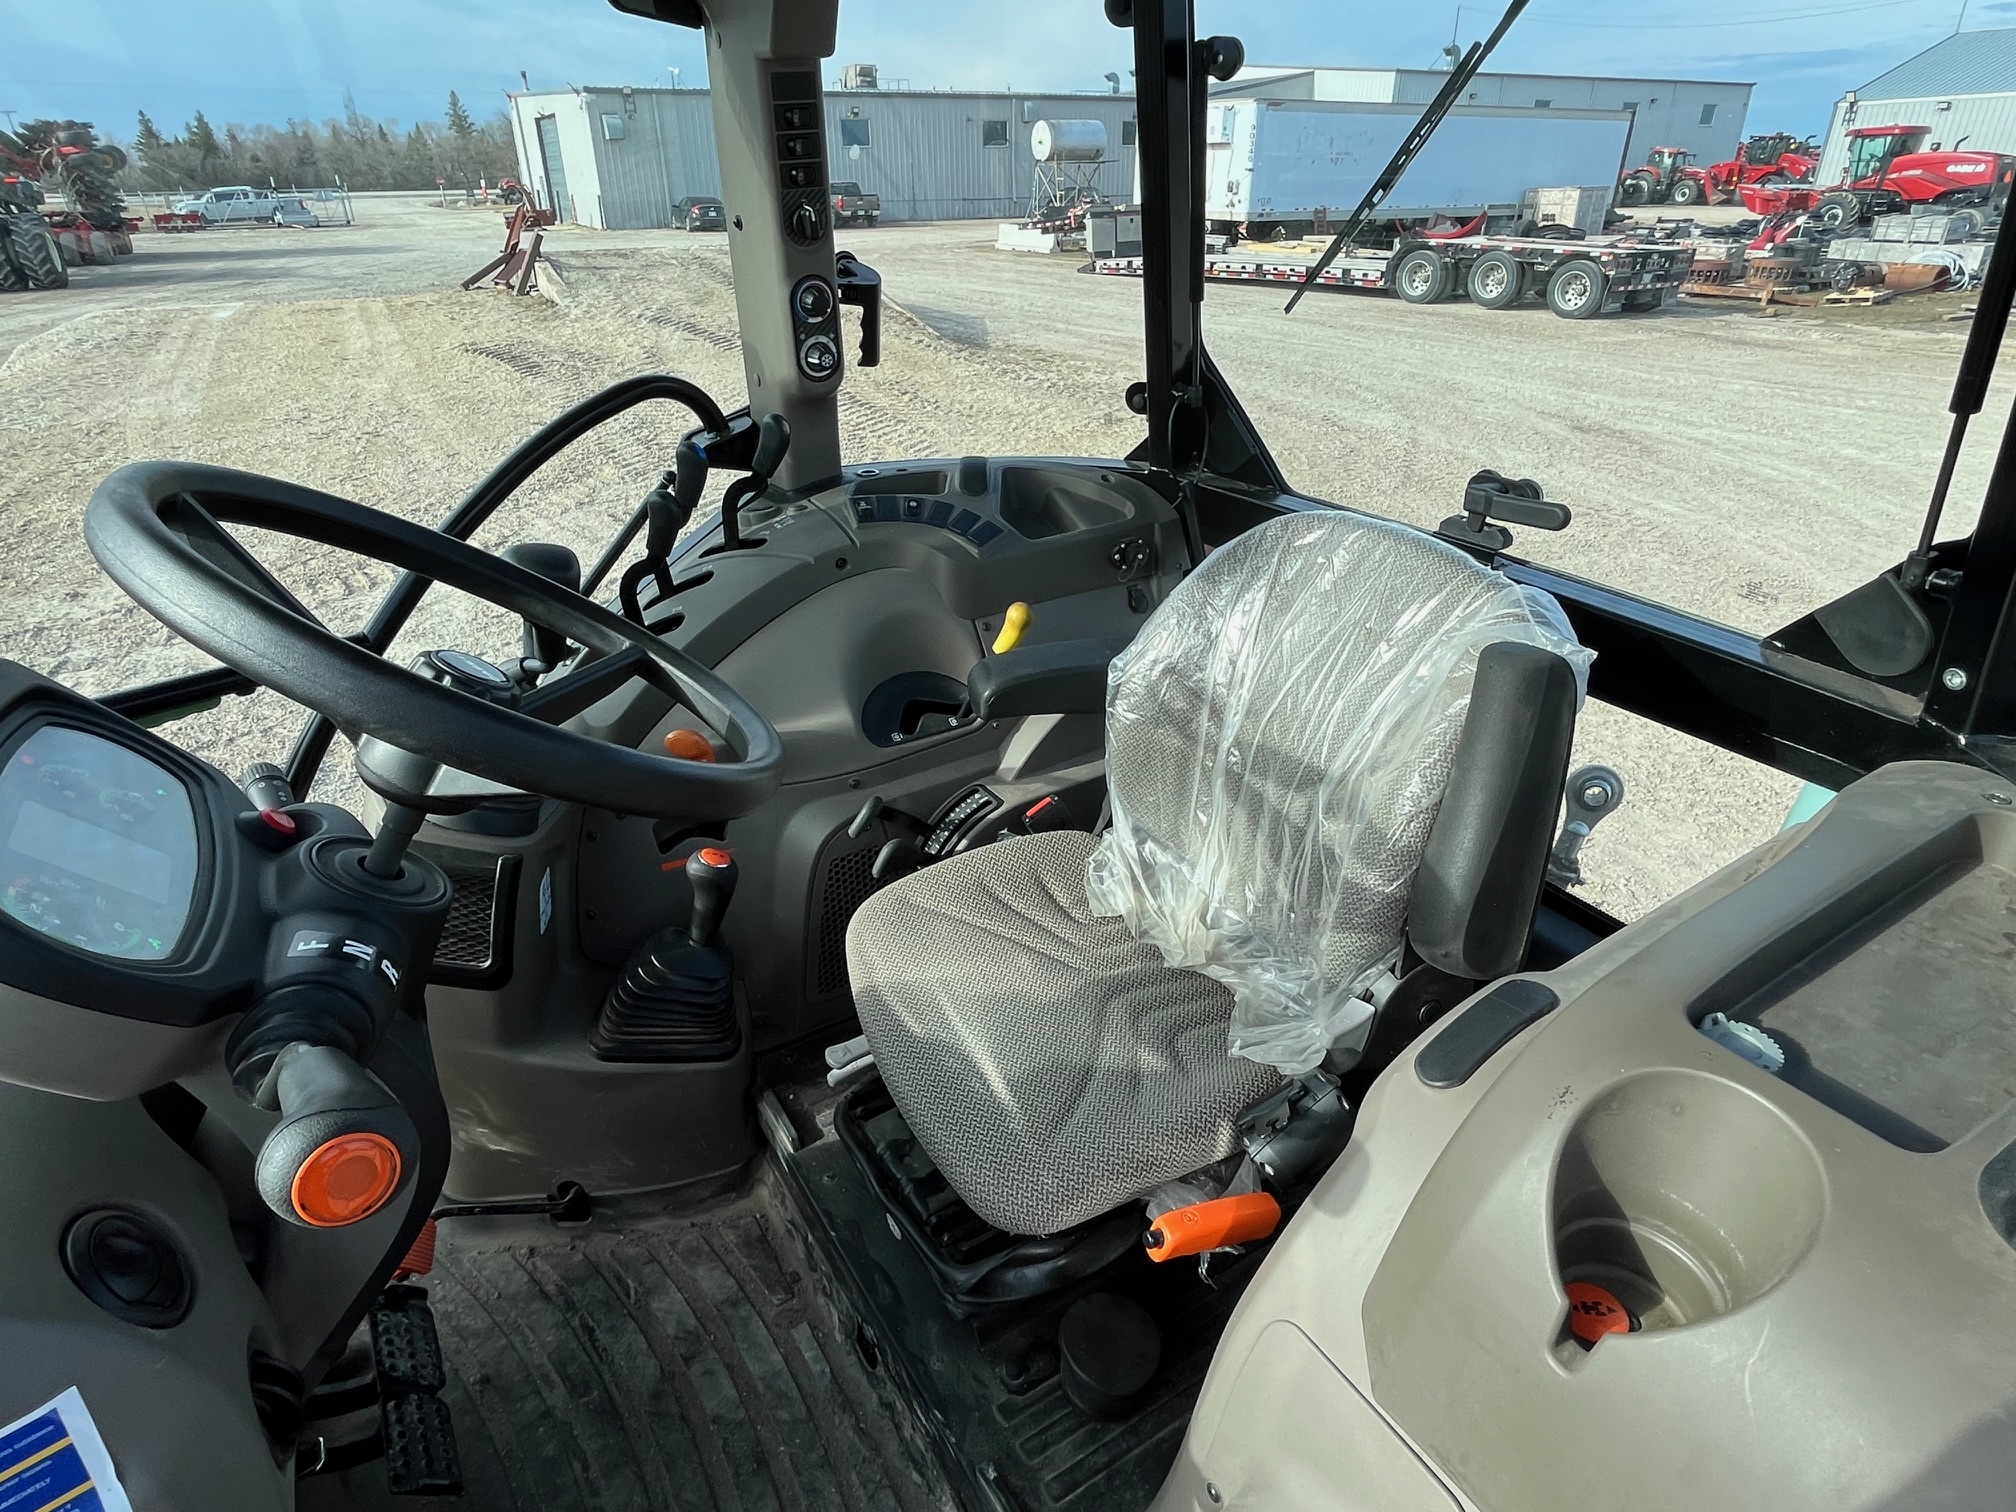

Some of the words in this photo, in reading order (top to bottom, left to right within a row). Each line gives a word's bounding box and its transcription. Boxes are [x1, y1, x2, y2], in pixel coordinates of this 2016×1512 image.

[1248, 124, 1256, 162] 90346
[297, 940, 330, 951] F
[342, 939, 374, 962] N
[380, 959, 399, 986] R
